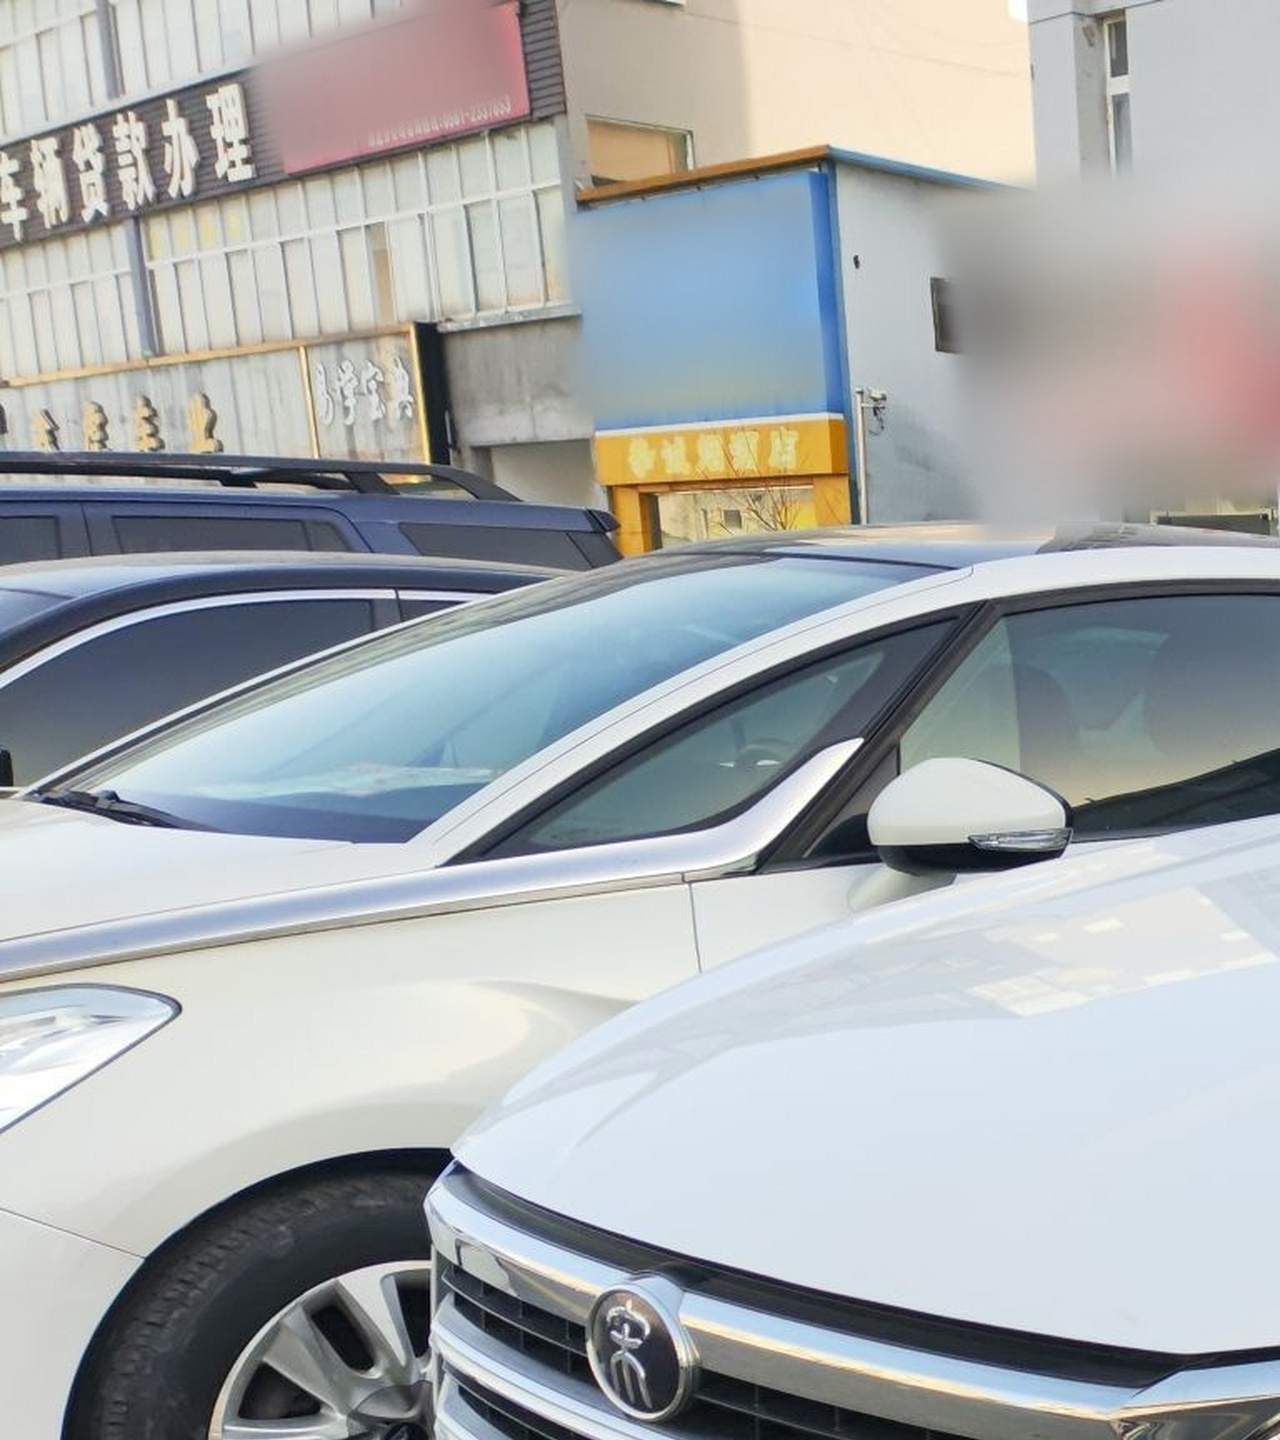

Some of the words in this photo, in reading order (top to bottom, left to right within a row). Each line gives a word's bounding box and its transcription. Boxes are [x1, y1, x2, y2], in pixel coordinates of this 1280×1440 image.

[0, 83, 256, 241] 车辆贷款办理
